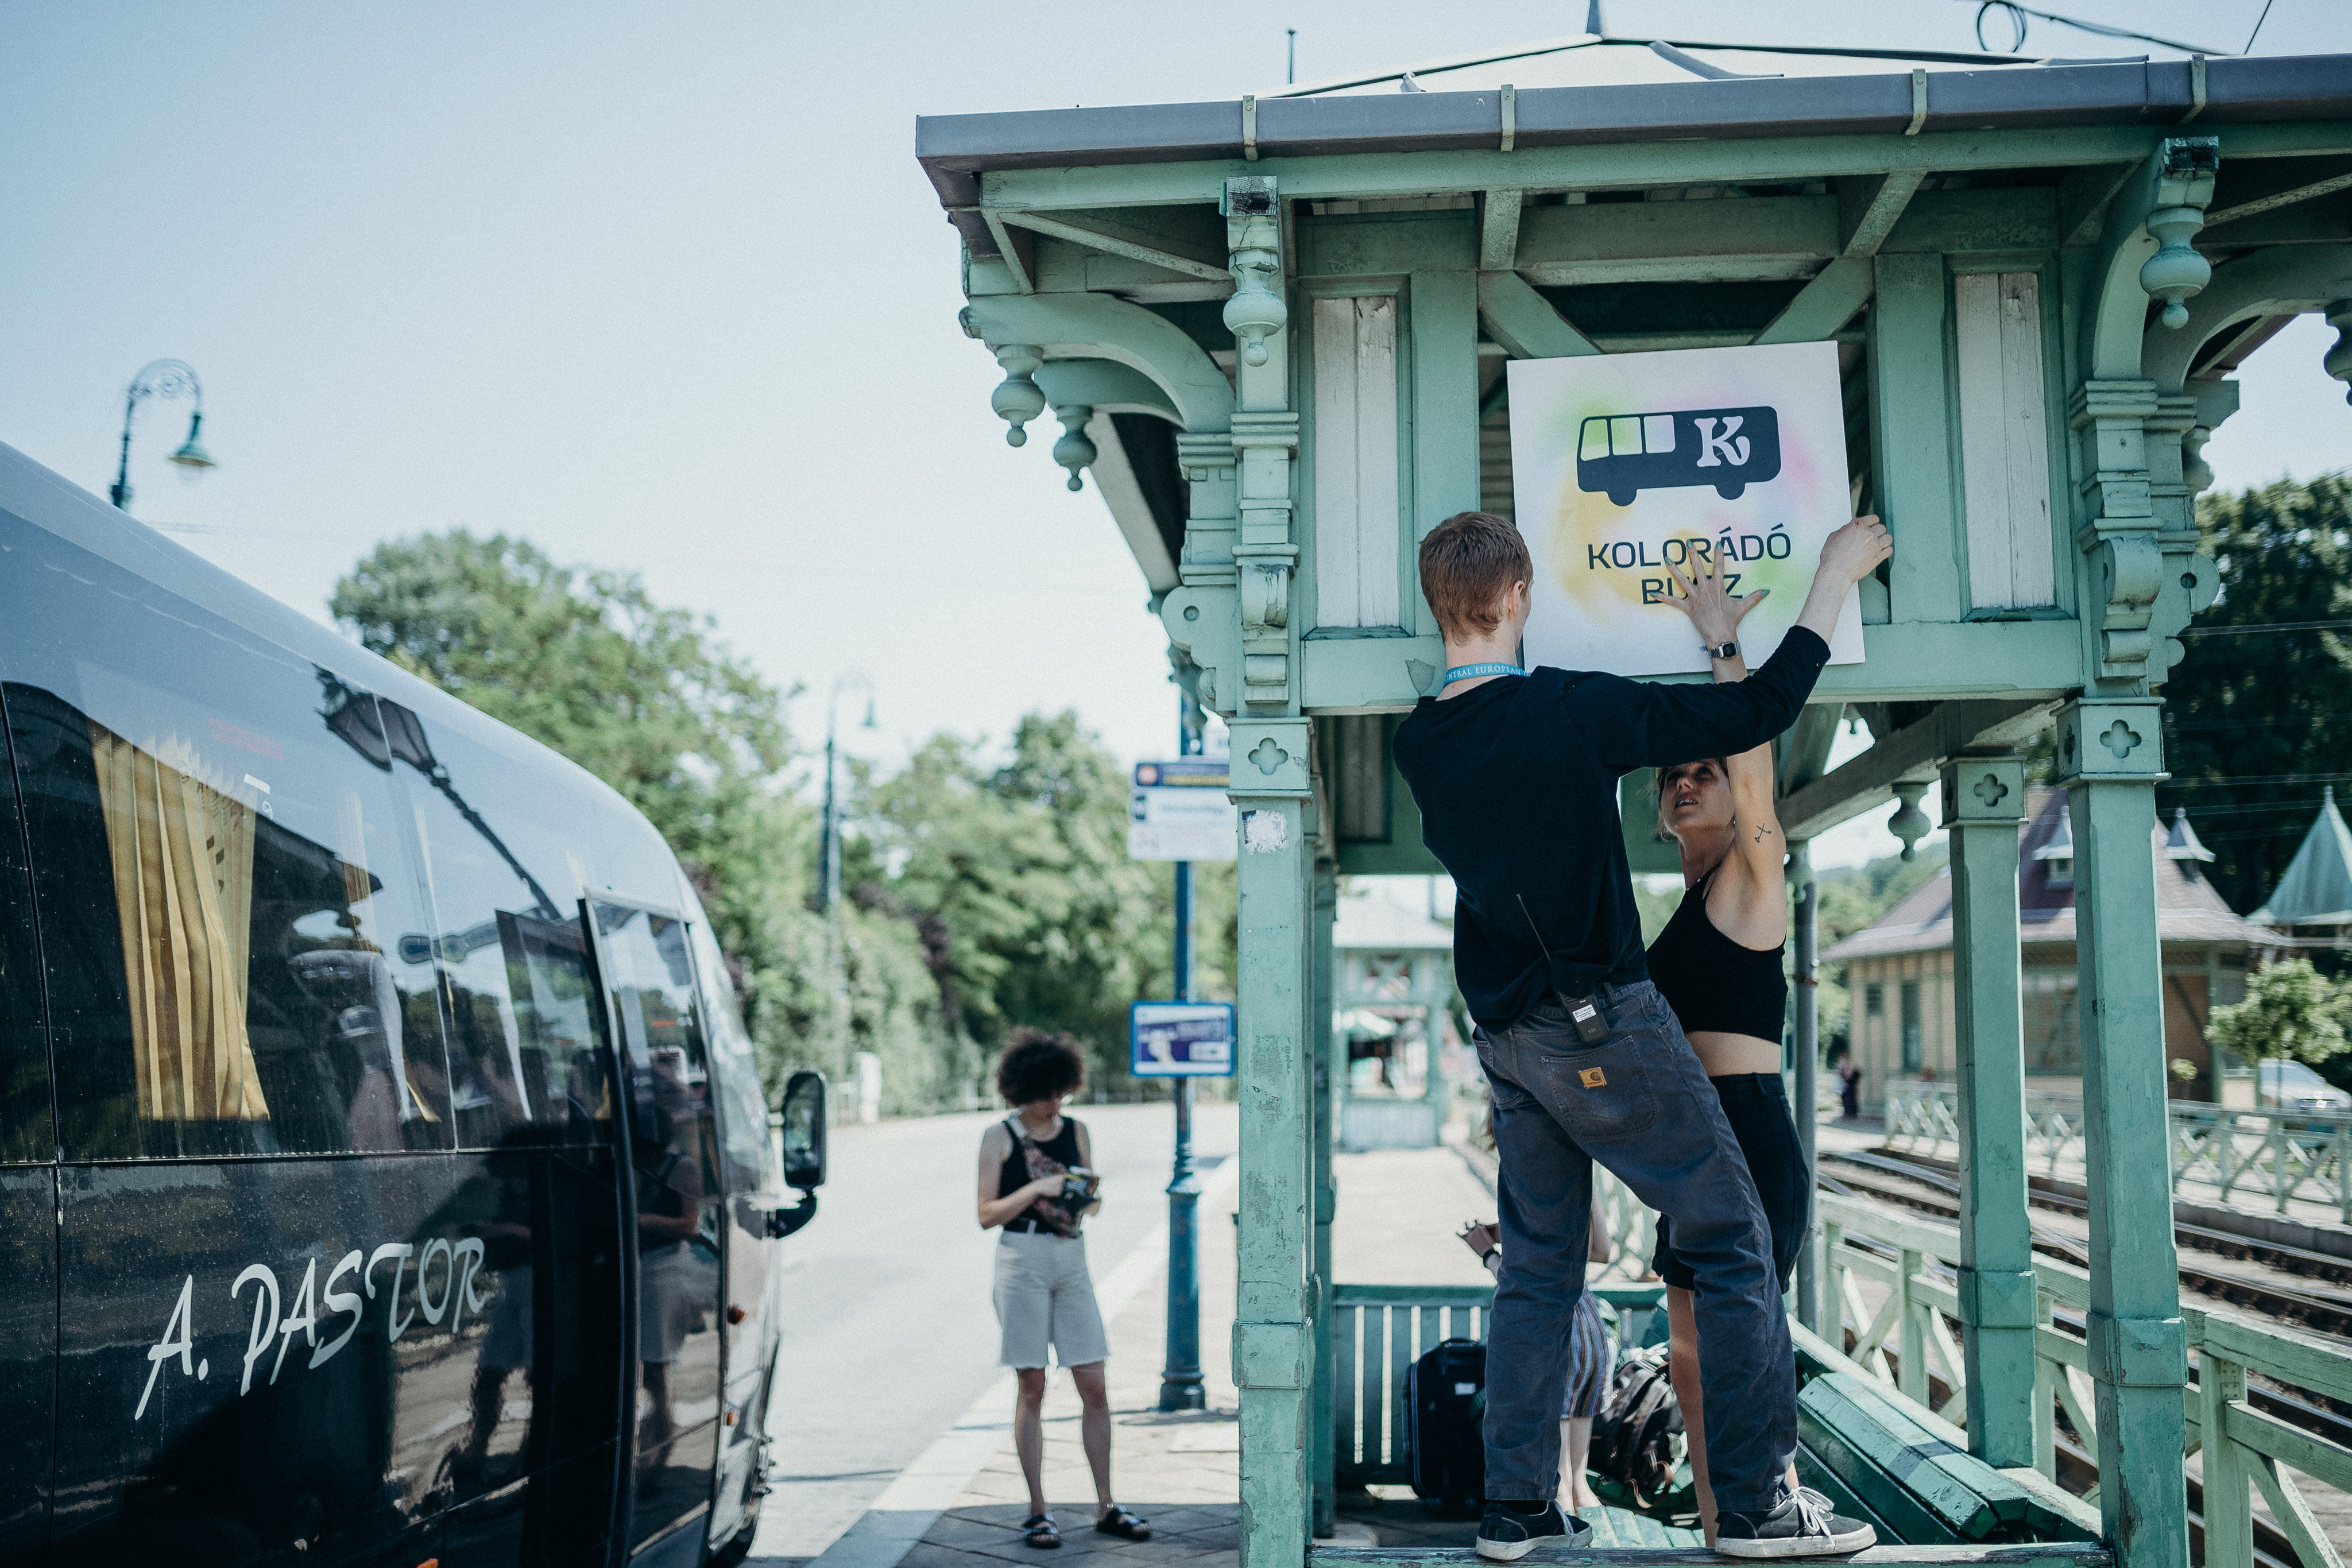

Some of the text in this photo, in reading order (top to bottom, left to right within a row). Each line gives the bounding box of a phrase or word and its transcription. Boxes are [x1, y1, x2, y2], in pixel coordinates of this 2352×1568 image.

[1694, 415, 1750, 467] K
[1587, 522, 1792, 570] KOLORÁDÓ
[1641, 573, 1743, 605] BUZ
[1475, 665, 1521, 676] EUROPEAN
[134, 1236, 488, 1420] A. PASTOR
